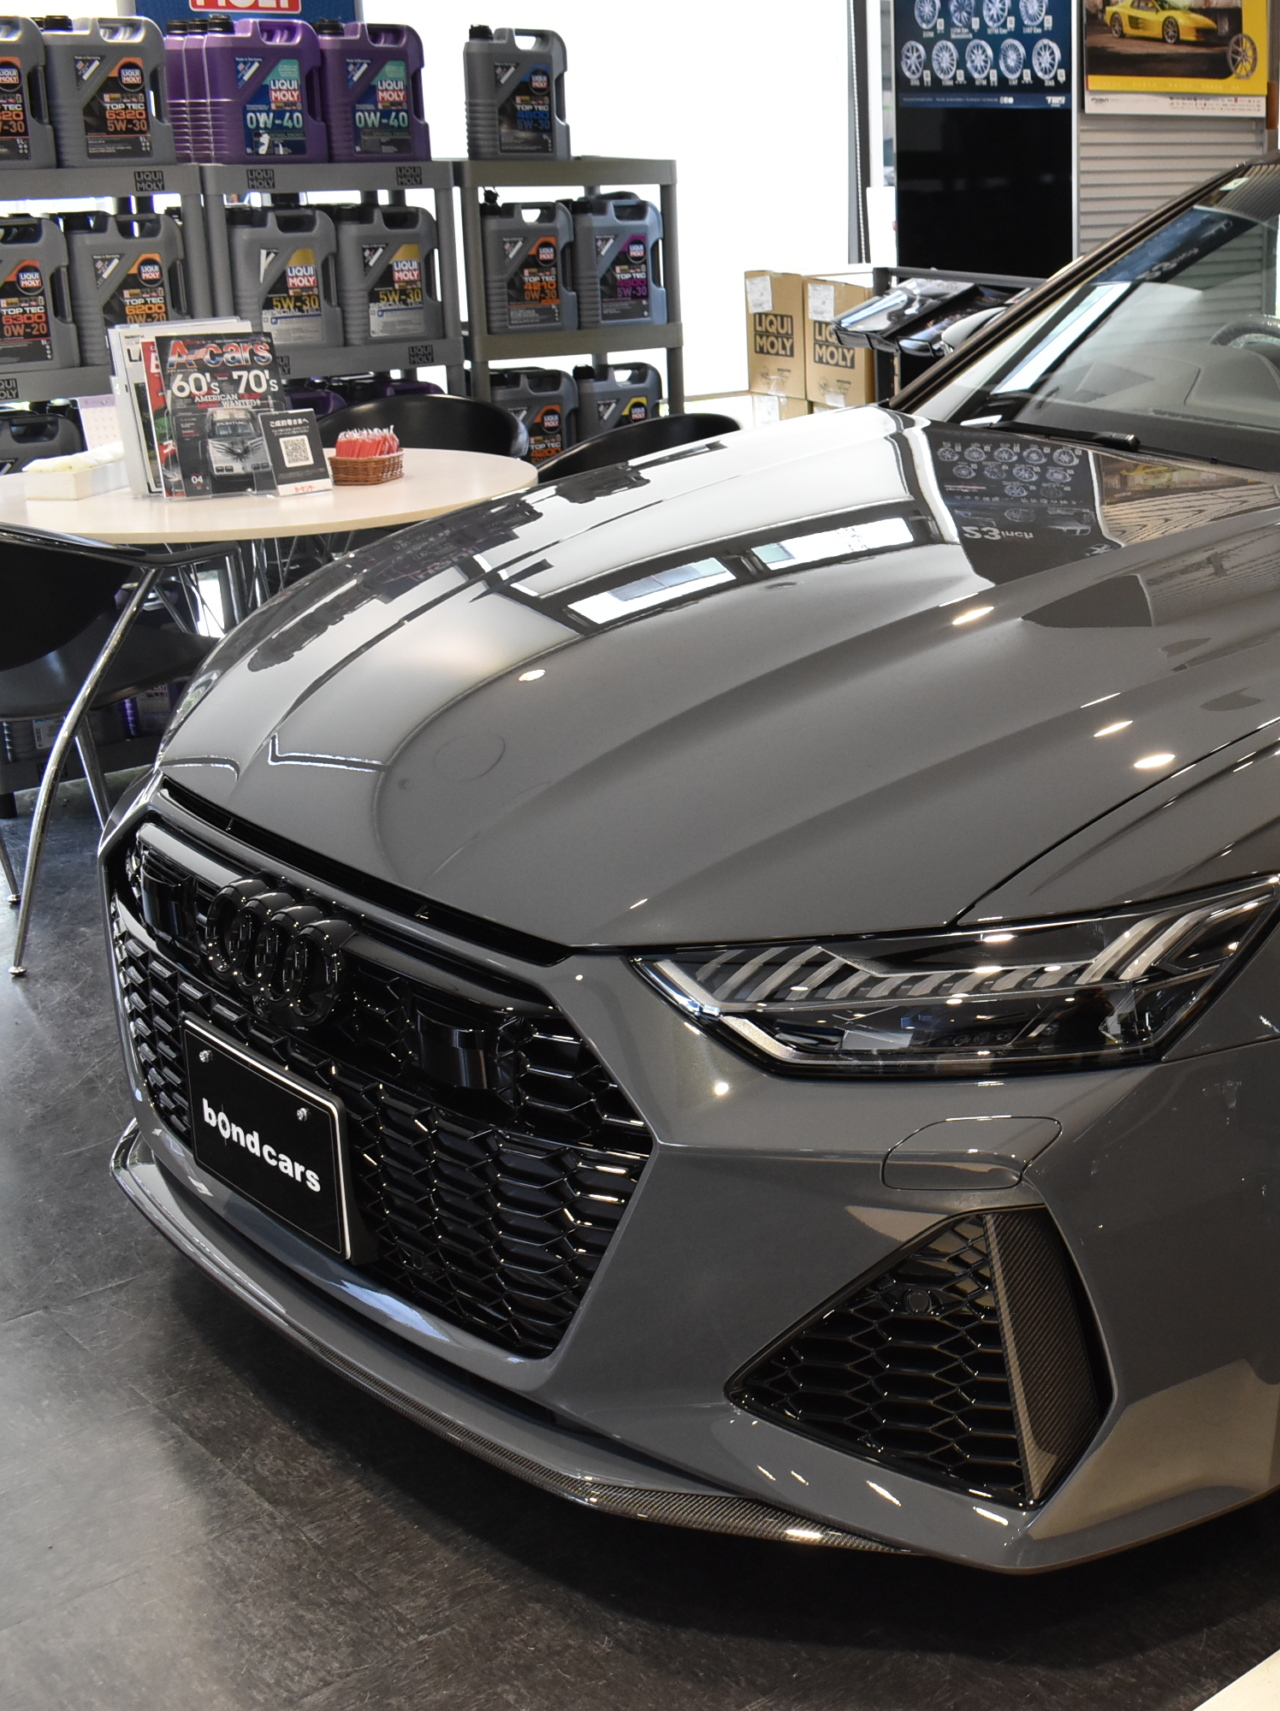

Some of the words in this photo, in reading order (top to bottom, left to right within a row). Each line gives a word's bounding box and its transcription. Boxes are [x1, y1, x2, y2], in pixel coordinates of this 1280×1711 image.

[122, 69, 141, 77] LIQUI
[122, 76, 142, 84] MOLY
[270, 80, 298, 89] LIQUI
[377, 80, 404, 90] LIQUI
[271, 90, 300, 101] MOLY
[378, 90, 406, 100] MOLY
[129, 102, 146, 110] TEC
[516, 103, 534, 111] TOP
[534, 103, 550, 111] TEC
[0, 111, 24, 121] 20
[105, 110, 147, 120] 6320
[246, 111, 304, 129] 0W-40
[355, 111, 409, 128] 0W-40
[0, 120, 26, 133] -30
[106, 119, 148, 132] 5W-30
[516, 119, 551, 130] 5W-30
[247, 169, 274, 179] LIQUI
[397, 166, 422, 176] LIQUI
[134, 172, 163, 181] LIQUI
[397, 176, 423, 185] MOLY
[136, 181, 165, 191] MOLY
[248, 179, 276, 189] MOLY
[140, 265, 160, 273] LIQUI
[286, 265, 314, 276] LIQUI
[392, 261, 419, 271] LIQUI
[18, 272, 40, 281] LIQUI
[141, 272, 161, 280] MOLY
[393, 270, 420, 281] MOLY
[523, 275, 541, 283] TOP
[542, 274, 557, 282] TEC
[20, 280, 42, 288] MOLY
[287, 276, 316, 287] MOLY
[379, 289, 422, 304] 5W-30
[524, 290, 557, 301] 0W-30
[617, 286, 648, 298] 5W-30
[272, 295, 319, 310] 5W-30
[1, 308, 24, 316] TOP
[25, 306, 45, 314] TEC
[125, 303, 166, 315] 6200
[2, 314, 46, 325] 6300
[126, 313, 167, 323] 0W-20
[755, 314, 793, 334] LIQUI
[3, 323, 48, 337] 0W-20
[755, 335, 794, 356] MOLY
[409, 346, 434, 356] LIQUI
[815, 344, 854, 367] MOLY
[410, 355, 435, 364] MOLY
[0, 380, 16, 391] QUI
[0, 390, 18, 399] OLY
[194, 393, 239, 403] AMERICAN
